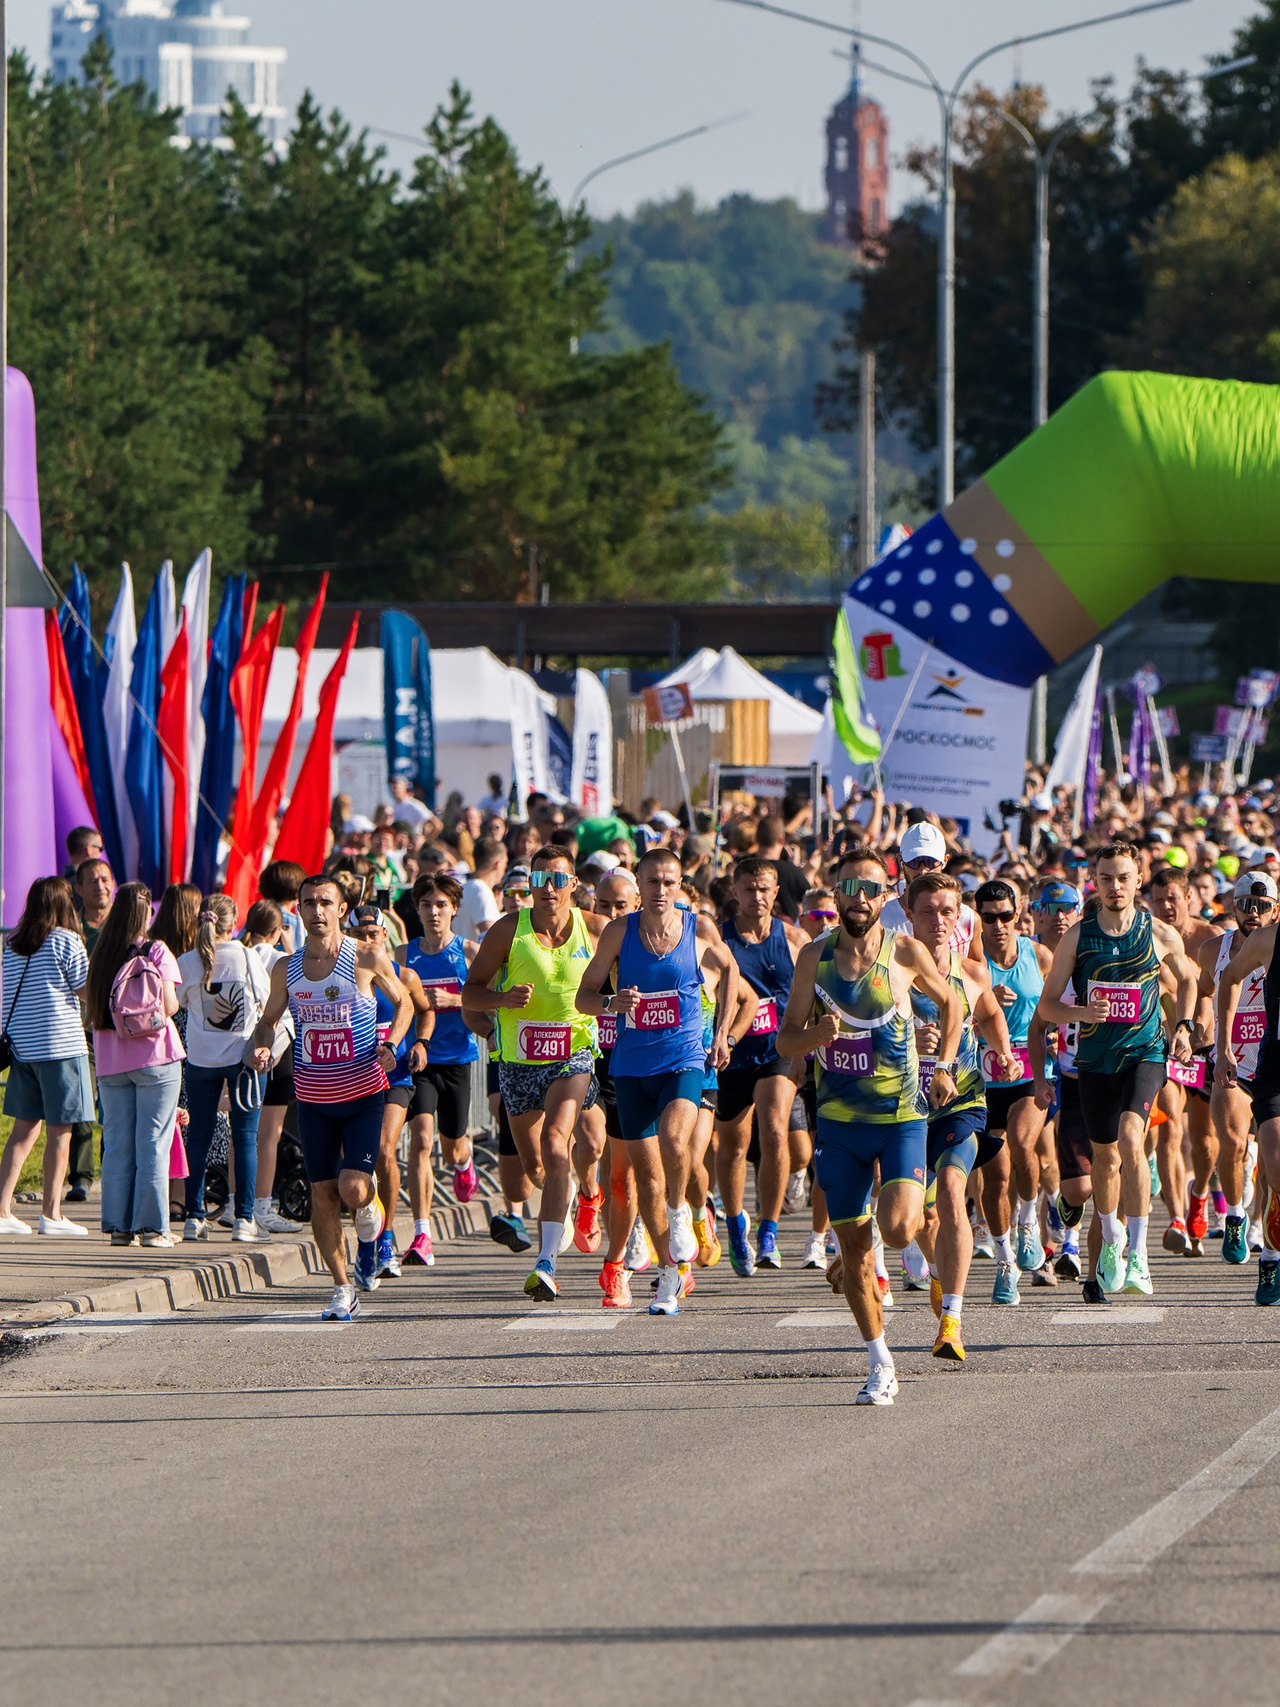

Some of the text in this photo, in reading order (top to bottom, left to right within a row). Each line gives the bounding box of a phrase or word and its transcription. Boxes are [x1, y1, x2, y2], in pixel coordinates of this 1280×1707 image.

[893, 728, 997, 751] РОСКОСМОС
[646, 1000, 668, 1010] СЕРГЕЙ
[1110, 992, 1128, 1001] АРТЁМ
[298, 1002, 352, 1023] RUSSIA
[641, 1009, 675, 1026] 4296
[1107, 1001, 1136, 1018] 033
[318, 1032, 345, 1042] ДМИТРИЙ
[533, 1030, 567, 1039] АЛЕКСАНДР
[1239, 1023, 1265, 1040] 325
[316, 1041, 350, 1059] 4714
[533, 1040, 565, 1056] 2491
[833, 1050, 869, 1071] 5210
[1175, 1069, 1198, 1084] 443
